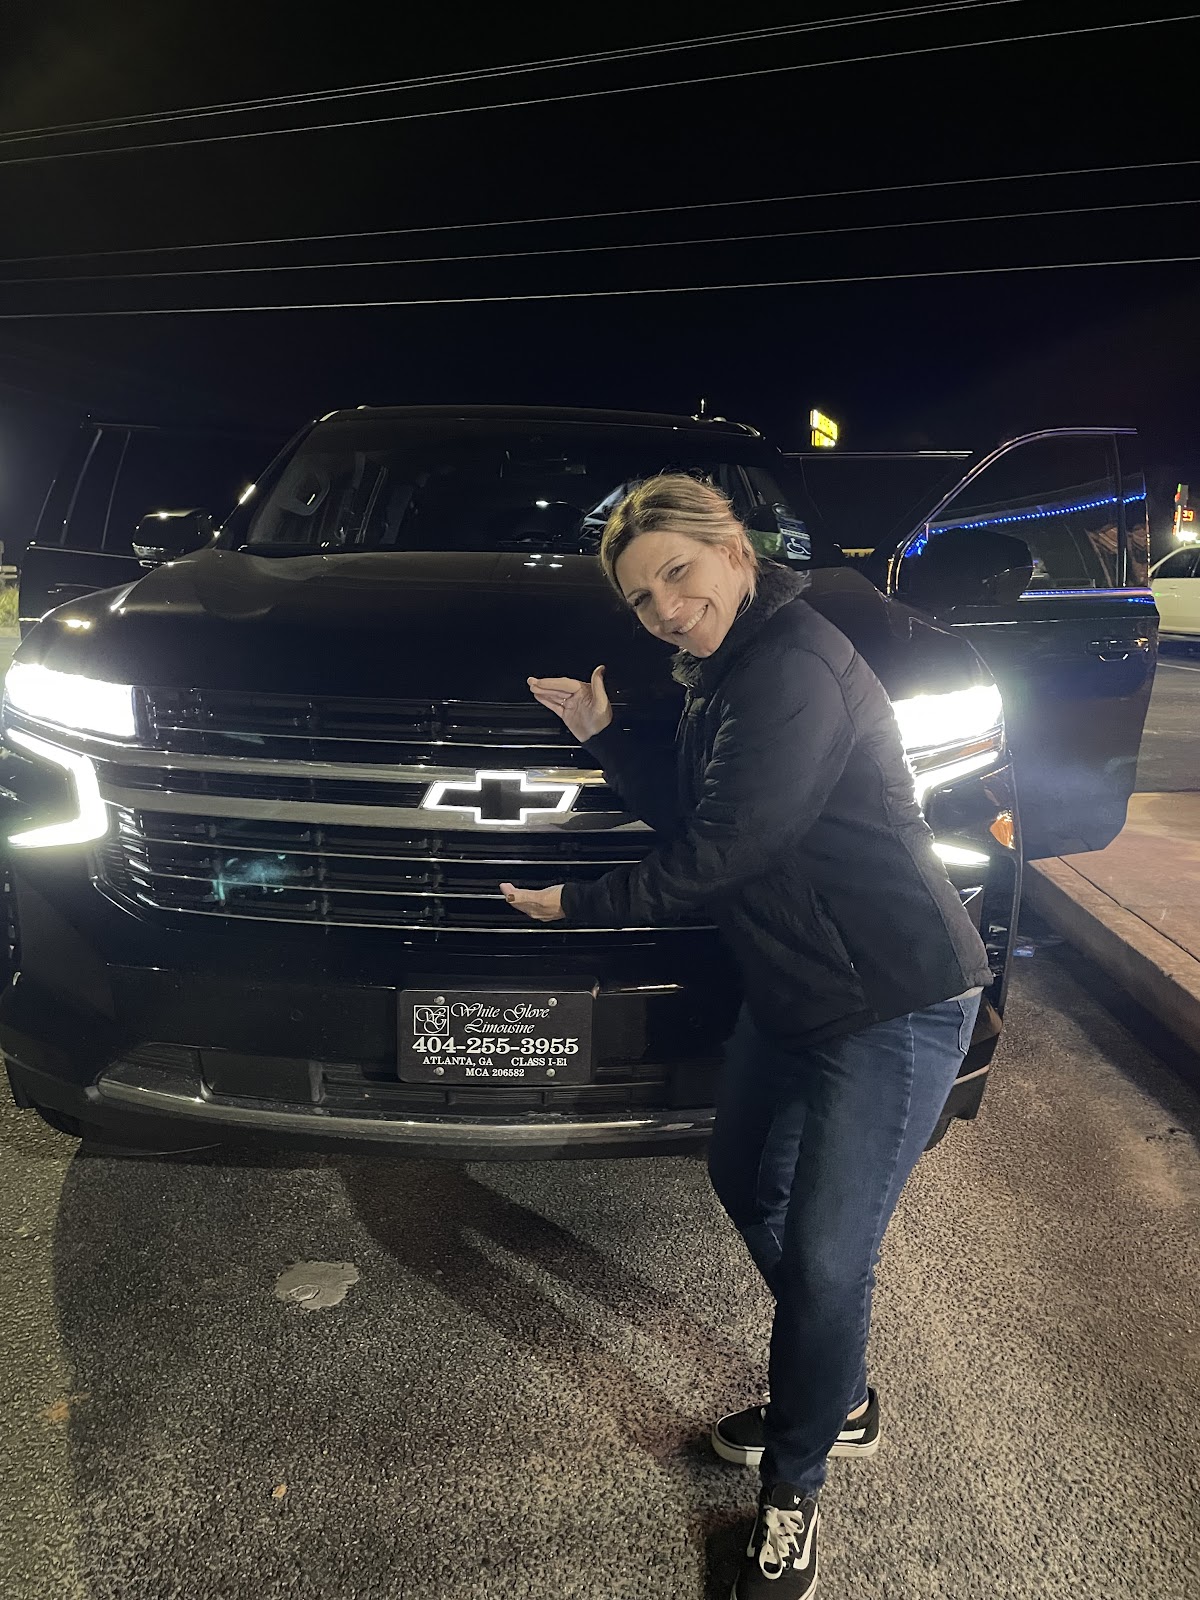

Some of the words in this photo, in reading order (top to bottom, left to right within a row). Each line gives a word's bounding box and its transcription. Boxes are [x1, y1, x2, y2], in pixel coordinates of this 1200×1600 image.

[451, 1002, 501, 1018] White
[503, 1003, 550, 1023] Glove
[464, 1017, 536, 1034] Limousine
[412, 1036, 579, 1055] 404-255-3955
[422, 1056, 477, 1067] ATLANTA,
[478, 1056, 494, 1066] GA
[510, 1056, 546, 1067] CLASS
[465, 1068, 490, 1077] MCA
[491, 1068, 525, 1077] 206582
